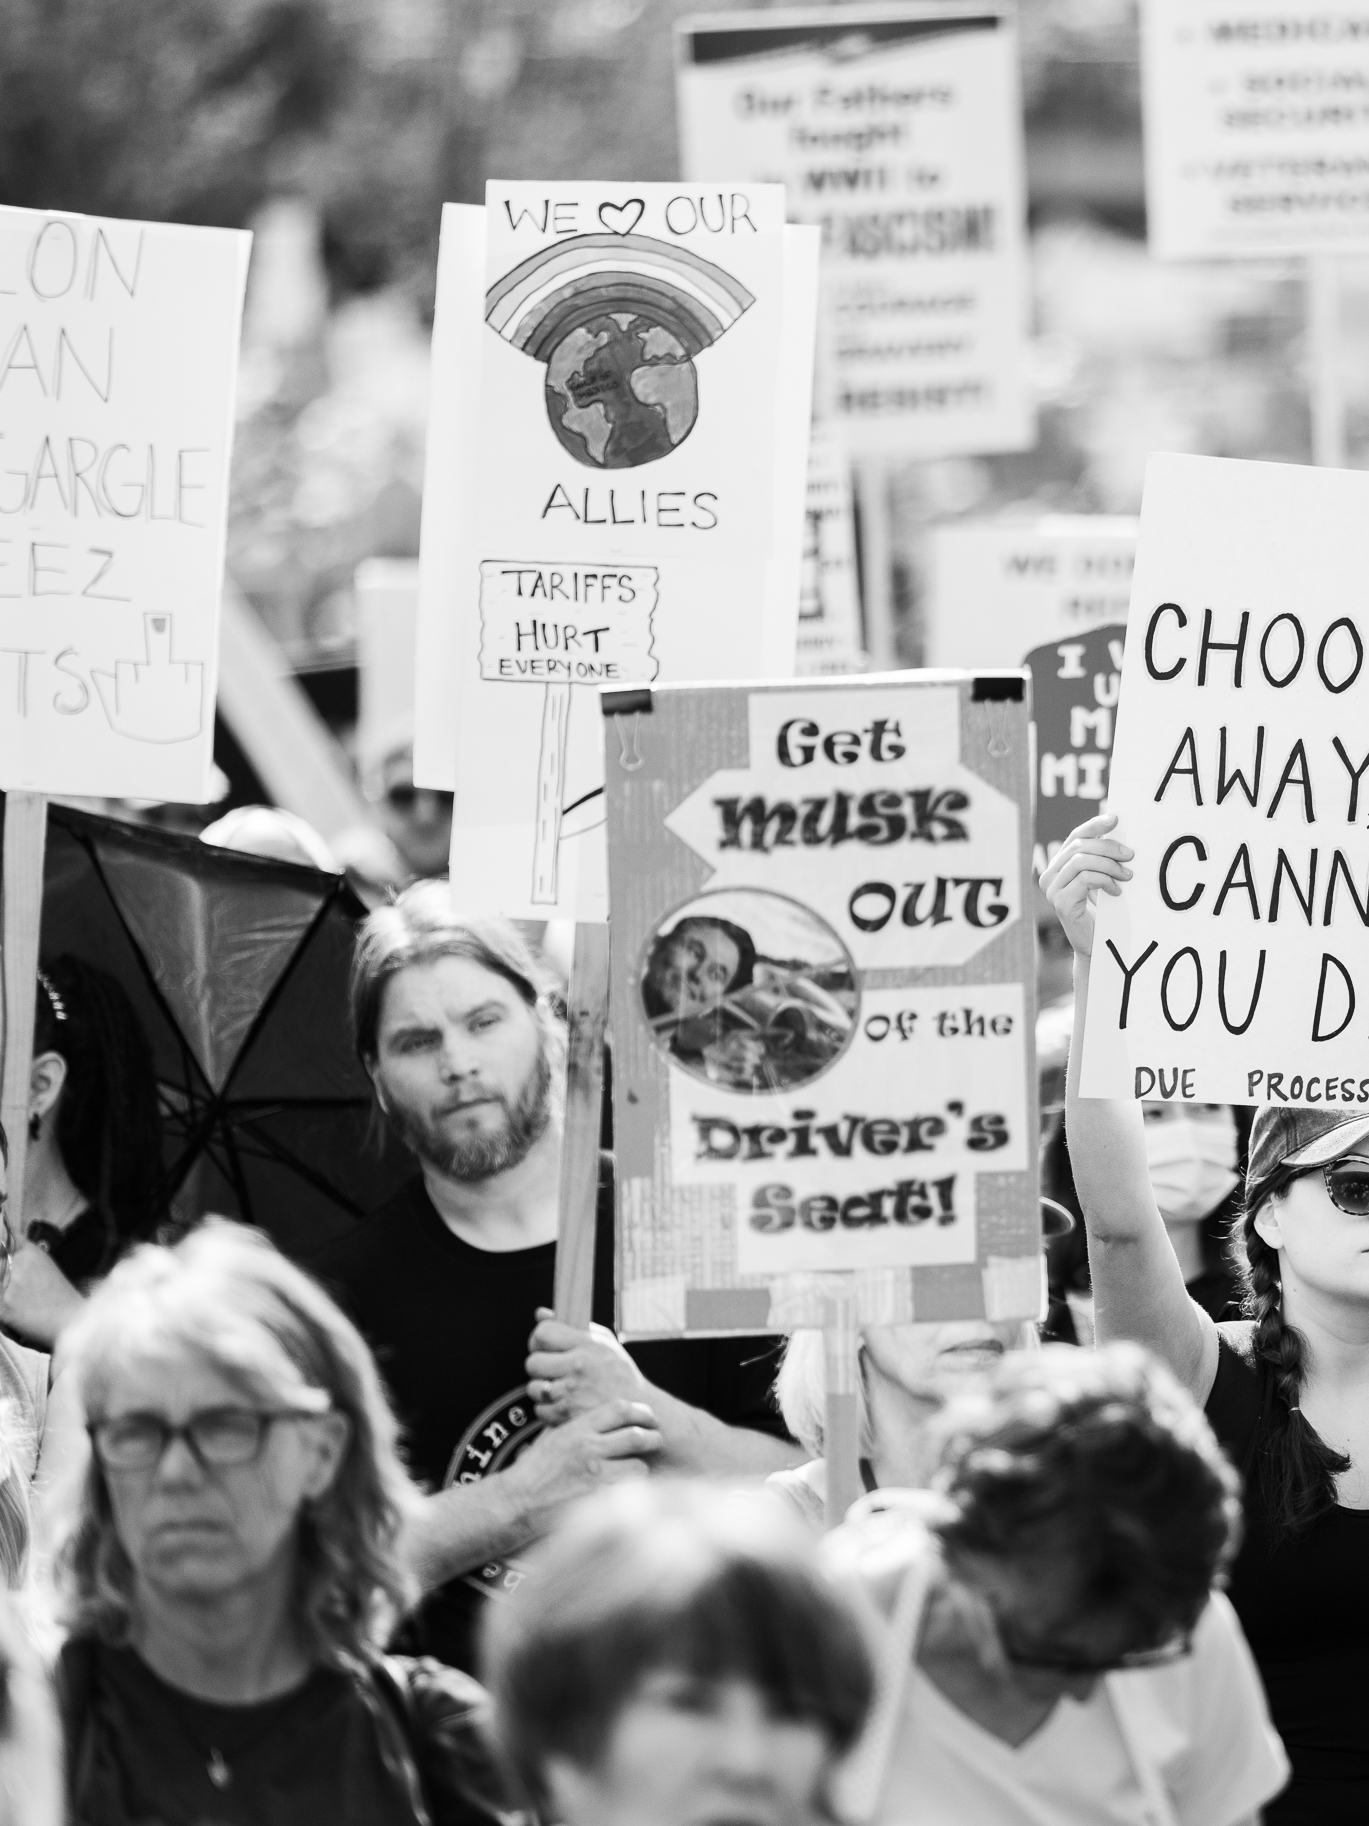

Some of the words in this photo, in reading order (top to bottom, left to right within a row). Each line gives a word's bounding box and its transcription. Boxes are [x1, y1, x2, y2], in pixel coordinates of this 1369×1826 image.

[504, 198, 579, 234] WE
[665, 194, 758, 235] OUR
[541, 483, 719, 530] ALLIES
[501, 569, 637, 603] TARIFFS
[516, 619, 611, 653] HURT
[499, 657, 621, 680] EVERYONE
[776, 719, 906, 768] Get
[1105, 938, 1267, 1036] YOU
[866, 1012, 918, 1043] of
[938, 1008, 1013, 1037] the
[1134, 1066, 1196, 1099] DUE
[692, 1100, 1010, 1161] Driver's
[752, 1174, 956, 1232] Seat!
